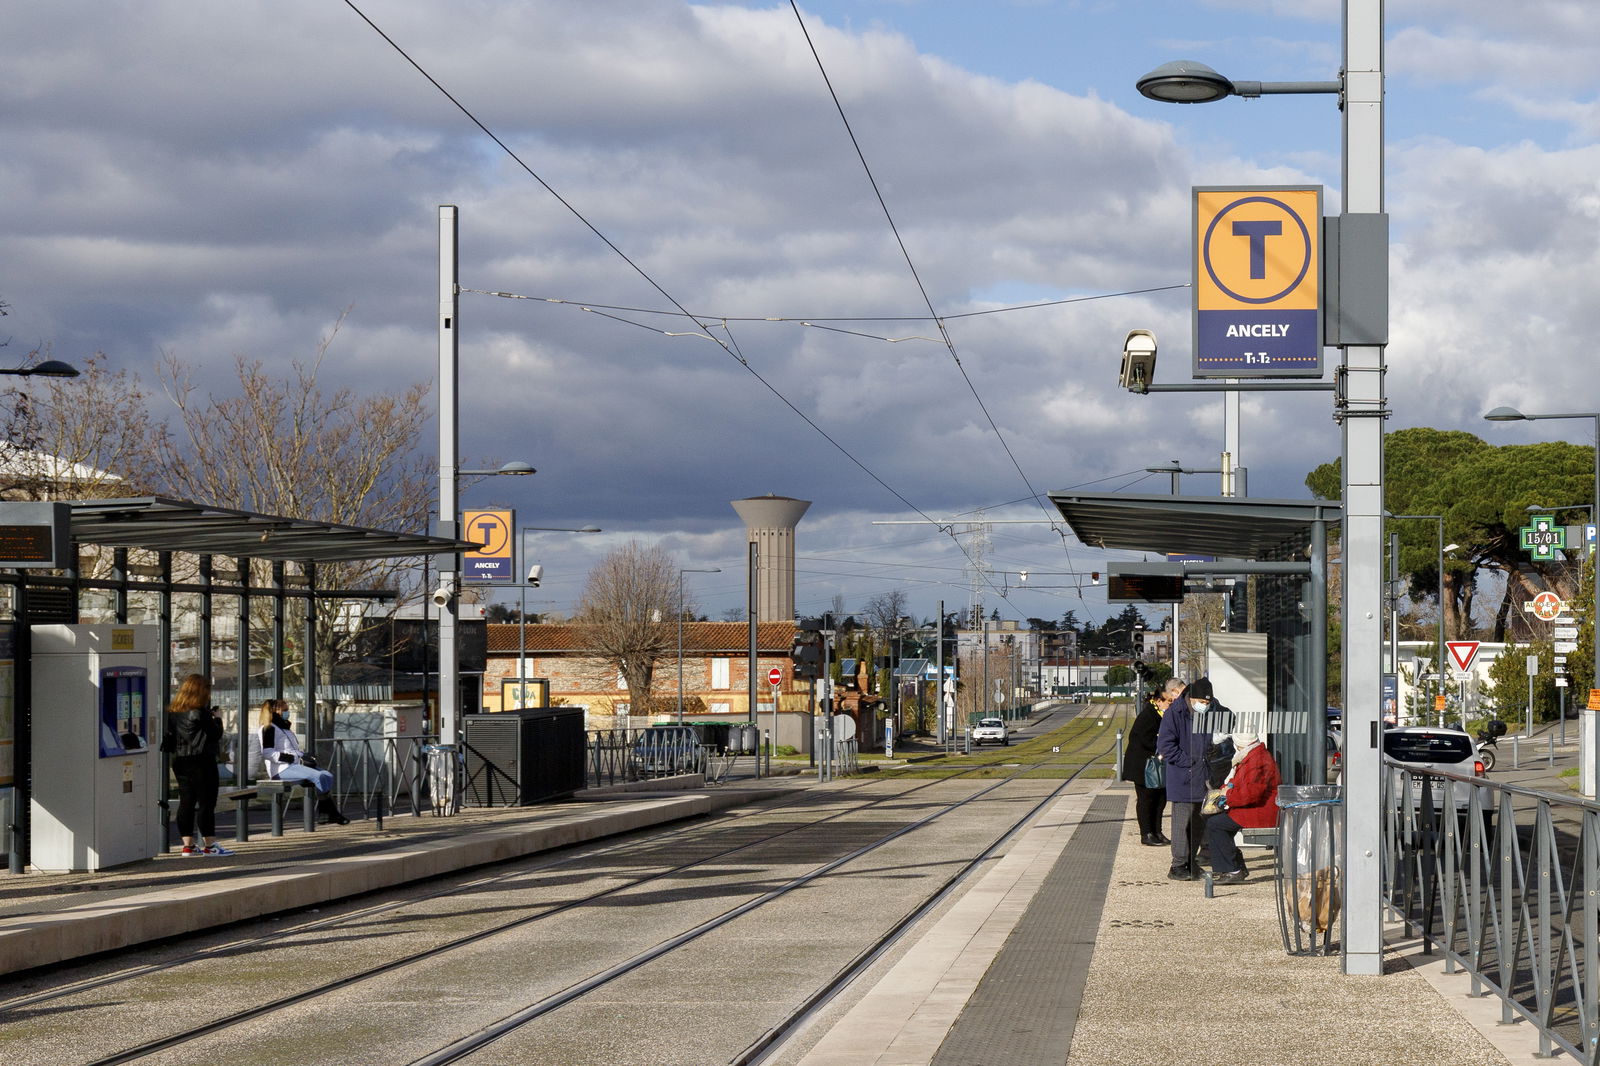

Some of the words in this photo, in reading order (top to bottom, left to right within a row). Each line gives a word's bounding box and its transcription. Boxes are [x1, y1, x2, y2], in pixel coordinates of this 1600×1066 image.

[1232, 221, 1282, 279] T
[1226, 324, 1290, 337] ANCELY
[478, 523, 497, 545] T
[1527, 533, 1559, 544] 15/01
